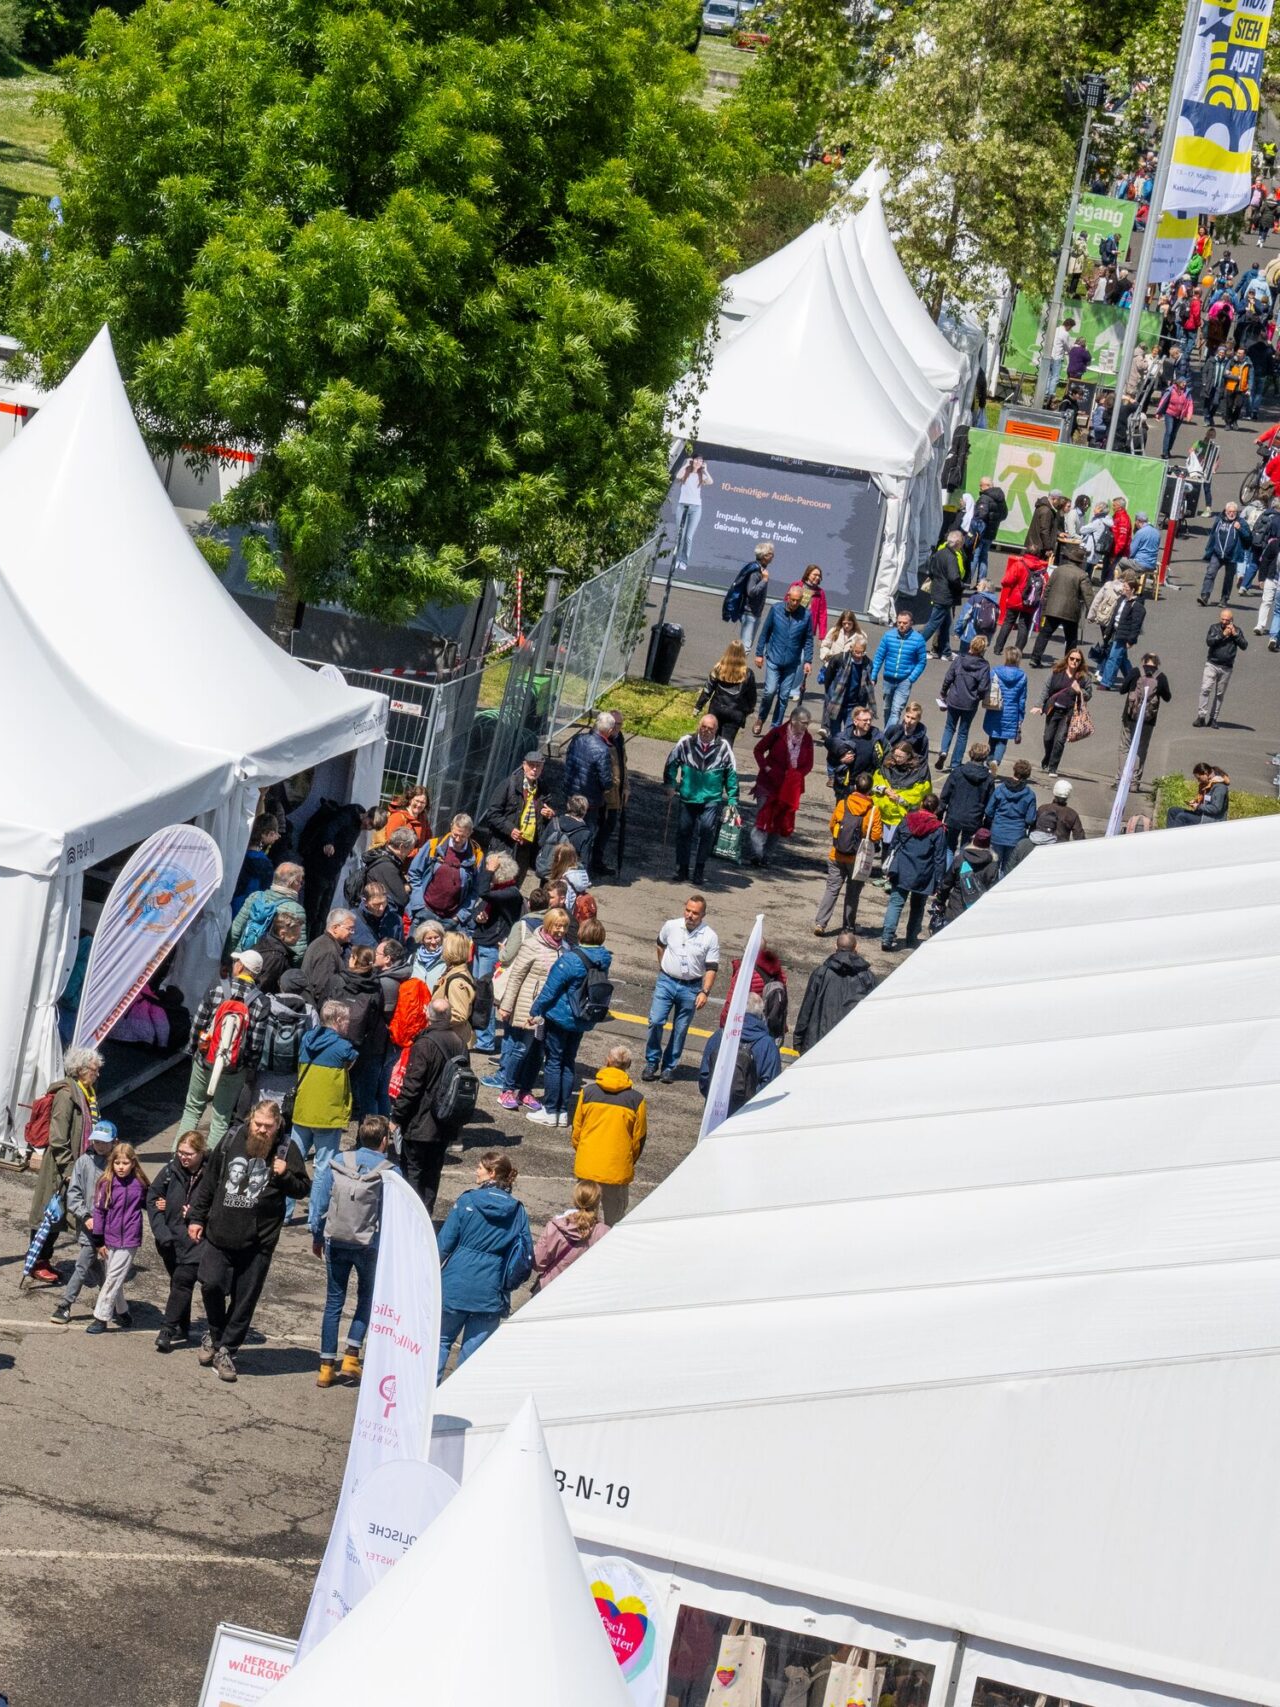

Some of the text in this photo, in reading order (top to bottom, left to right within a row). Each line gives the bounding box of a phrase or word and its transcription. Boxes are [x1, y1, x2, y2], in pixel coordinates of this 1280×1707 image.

[1234, 17, 1263, 42] STEH
[1229, 50, 1260, 74] AUF!
[1075, 203, 1124, 228] sgang
[721, 481, 832, 510] 10-minütiger Audio-Parcours
[713, 522, 797, 545] deinen Weg zu finden
[715, 510, 804, 535] Impulse, die dir helfen,
[554, 1469, 630, 1508] B-N-19
[228, 1659, 285, 1681] WILLKOM
[243, 1654, 292, 1674] HERZLIC
